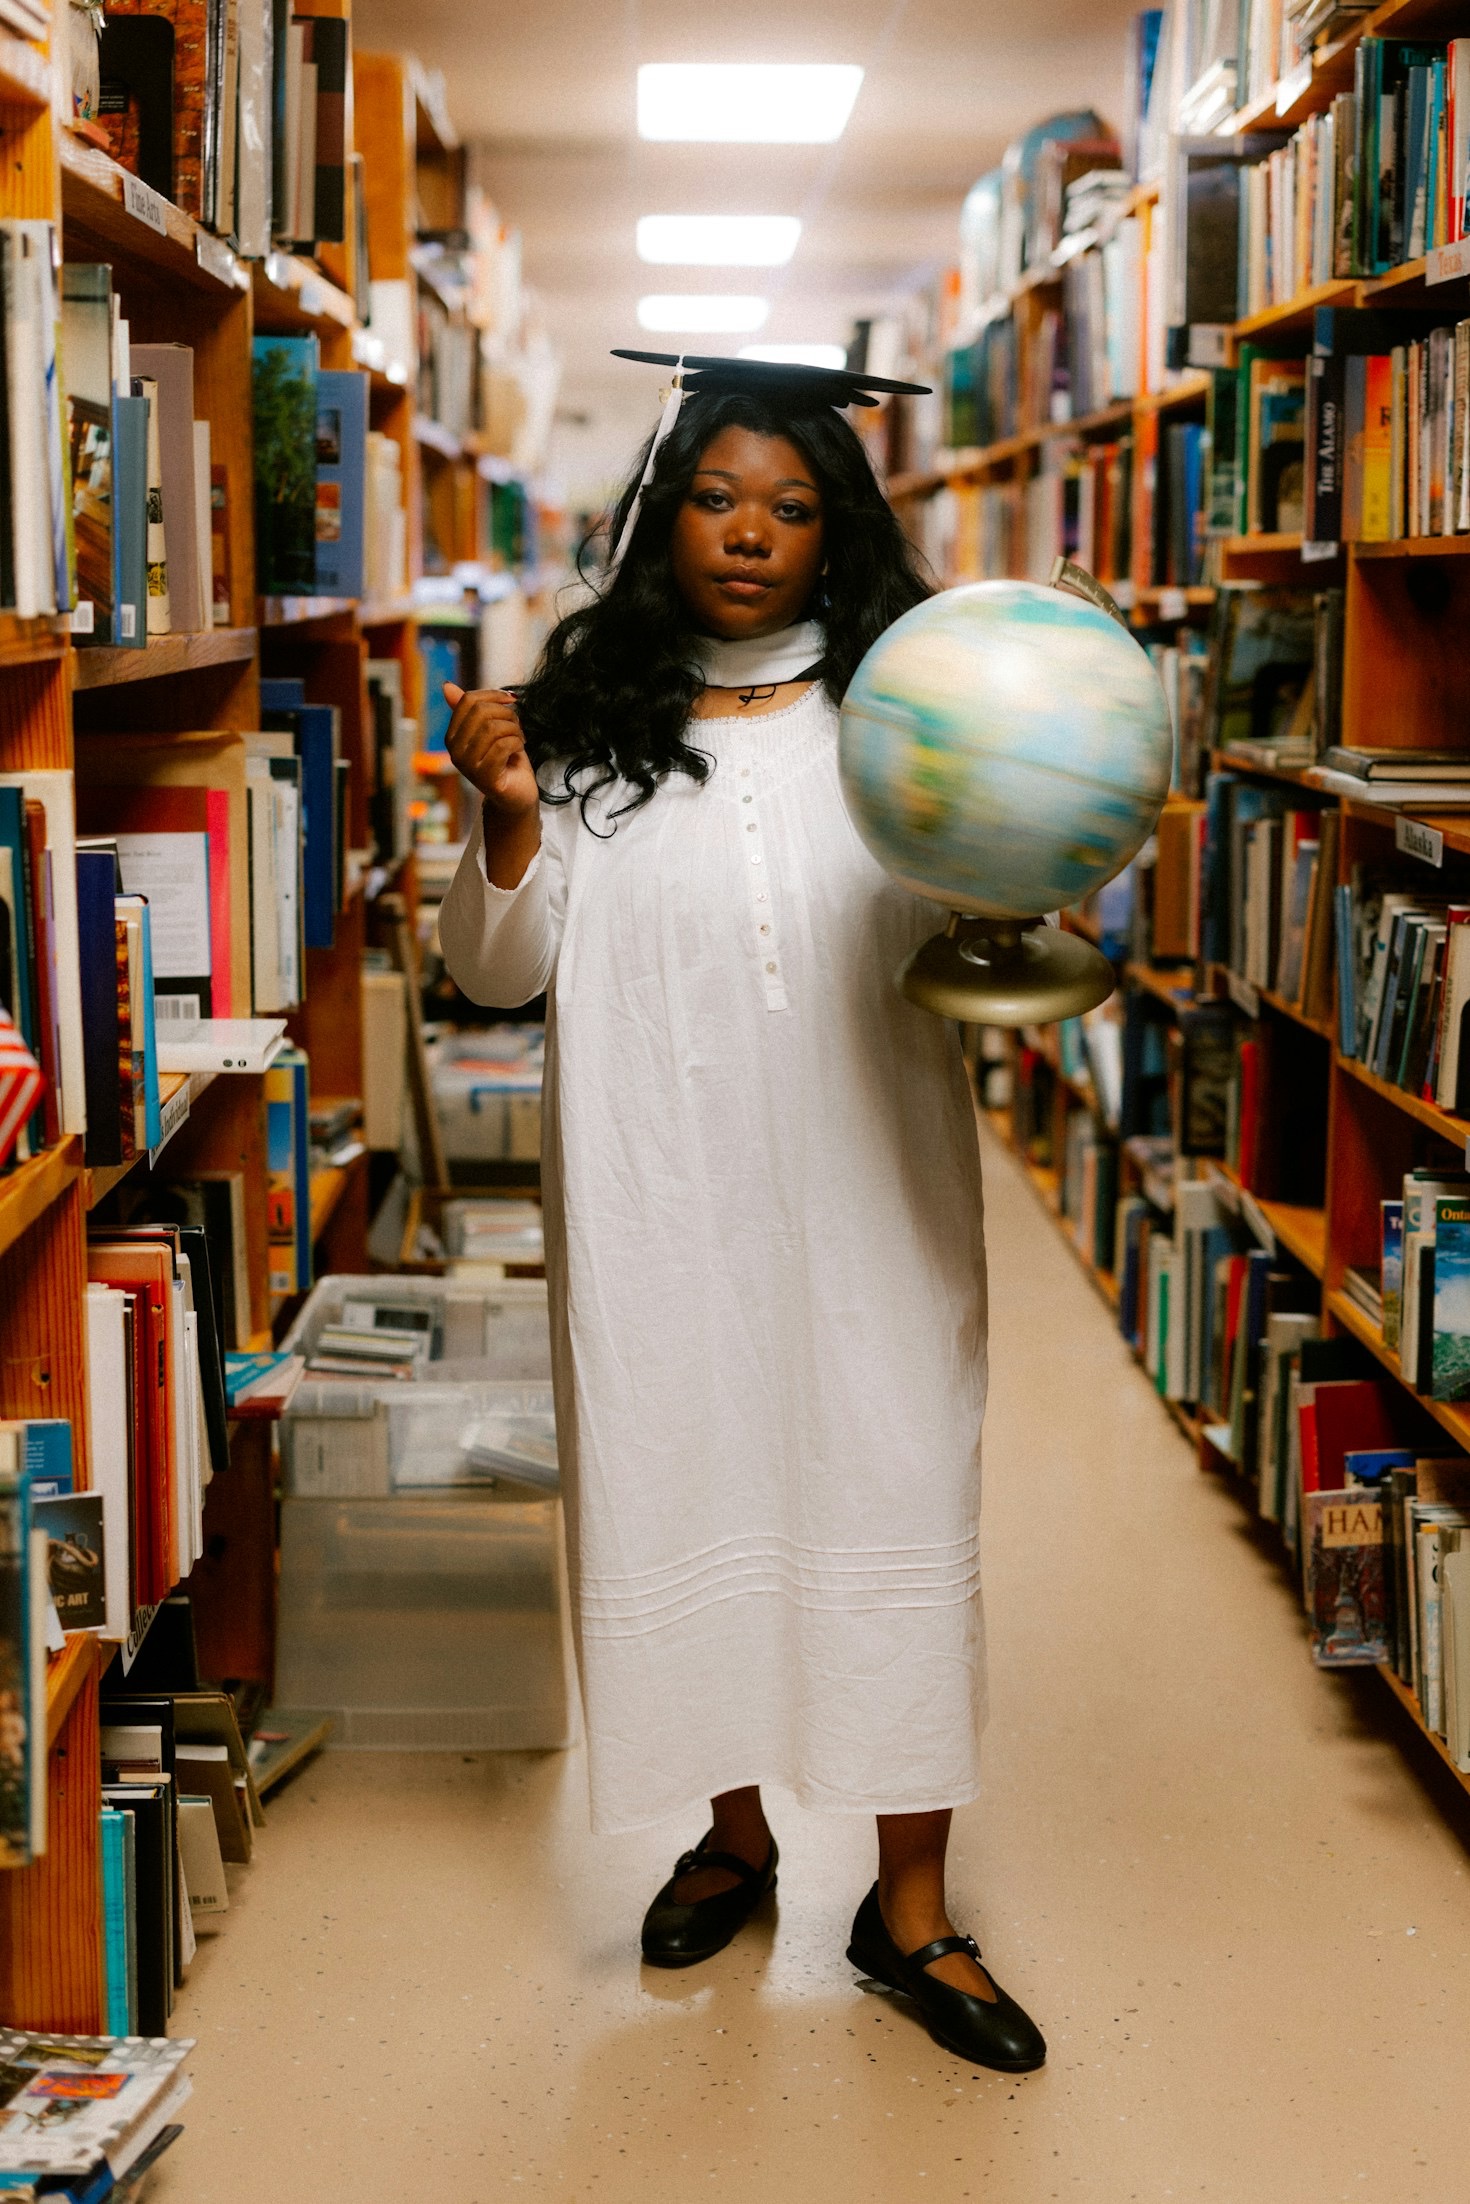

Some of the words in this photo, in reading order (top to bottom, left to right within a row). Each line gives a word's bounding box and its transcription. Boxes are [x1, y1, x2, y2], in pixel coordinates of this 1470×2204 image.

[146, 192, 161, 226] Arts
[1403, 823, 1433, 859] Alaska
[67, 1591, 90, 1607] ART
